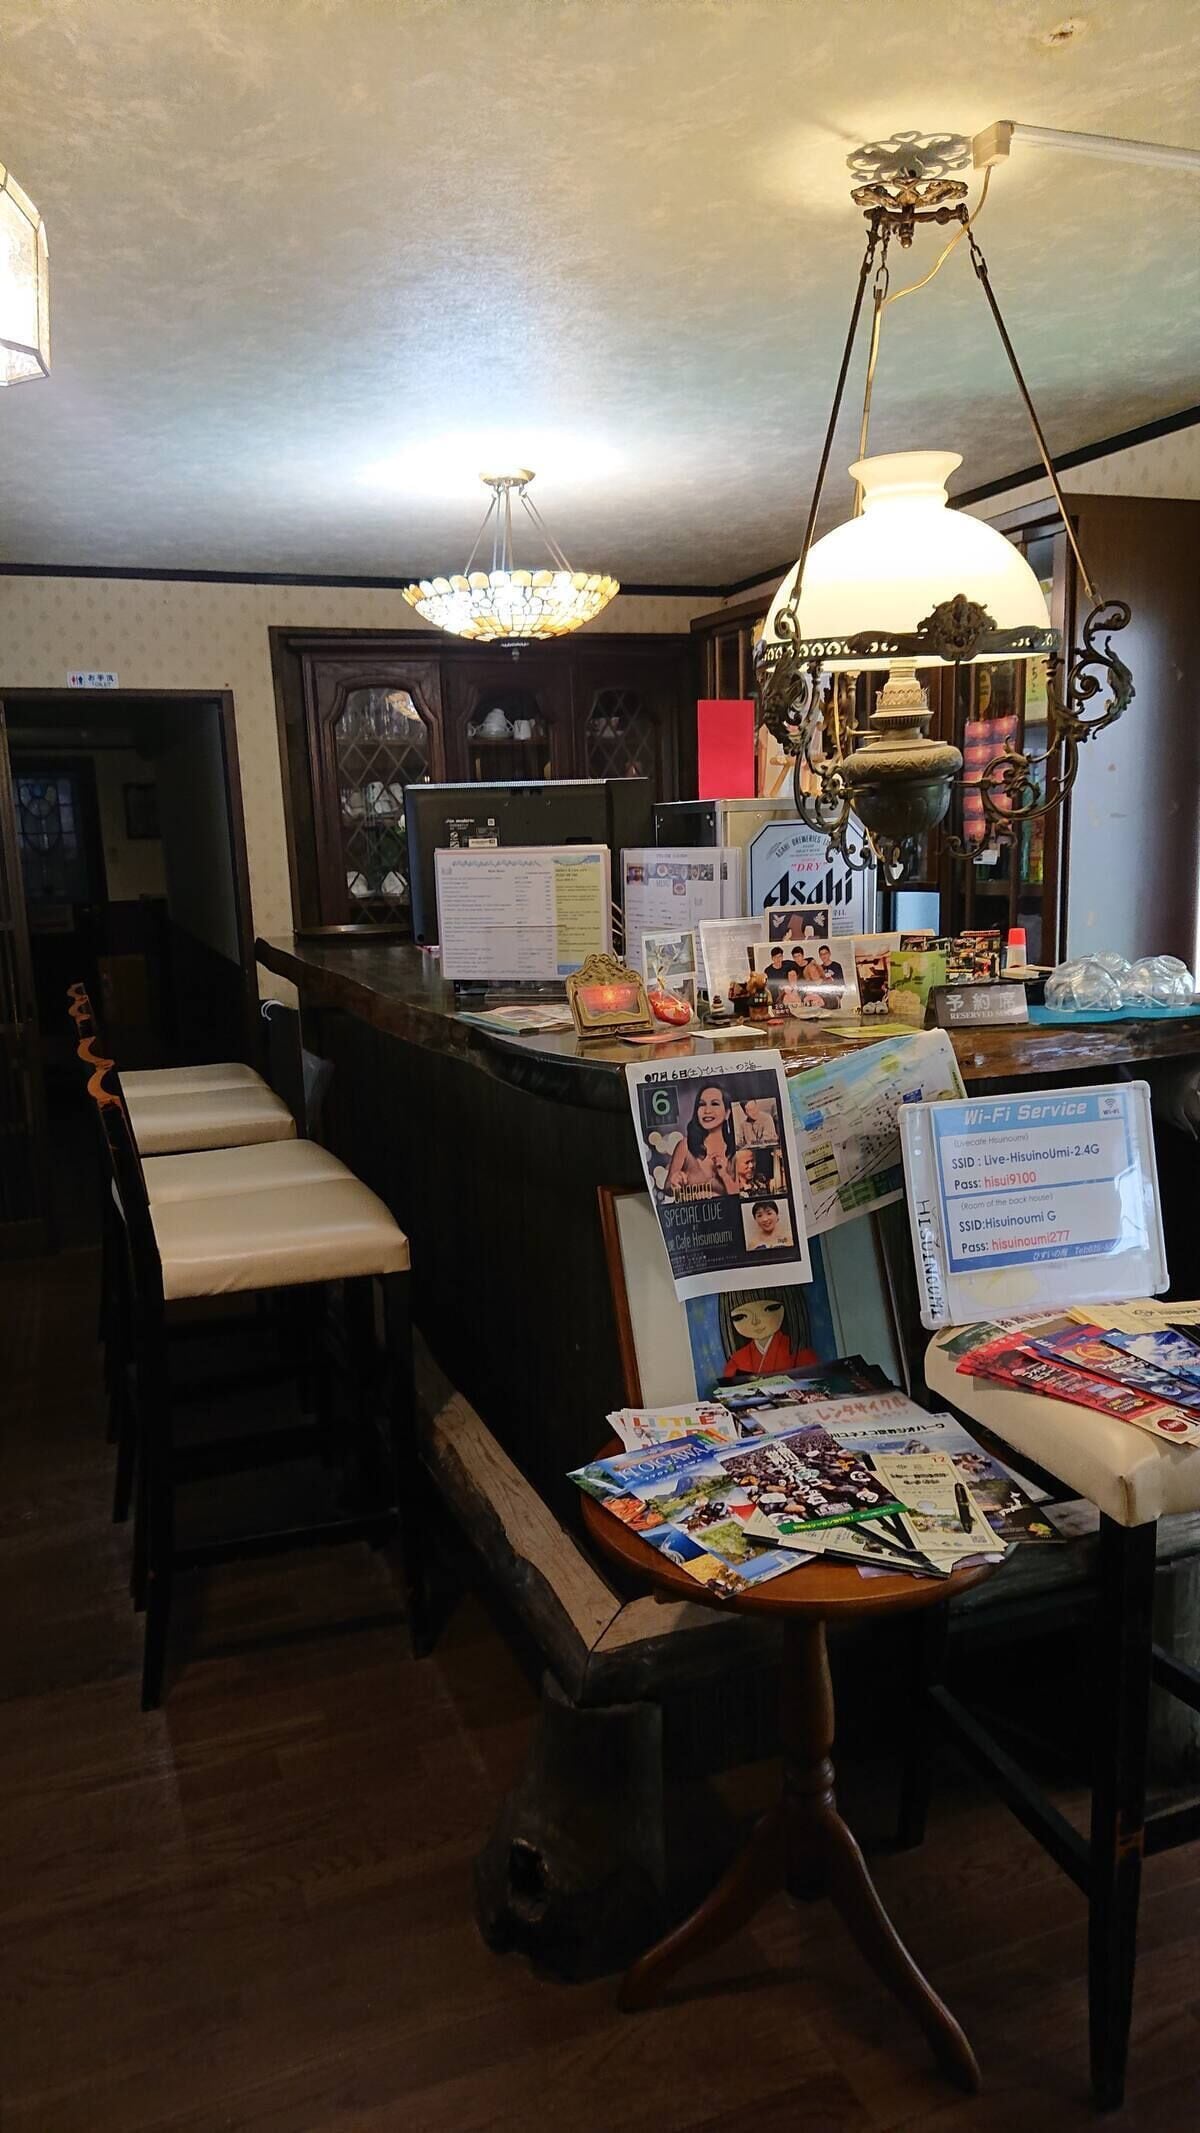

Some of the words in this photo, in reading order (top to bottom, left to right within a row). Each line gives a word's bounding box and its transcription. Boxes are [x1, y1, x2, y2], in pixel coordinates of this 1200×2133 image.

[763, 867, 853, 908] Asahi
[950, 1011, 994, 1020] RESERVED
[652, 1089, 671, 1116] 6
[964, 1107, 1011, 1126] Wi-Fi
[1017, 1101, 1087, 1121] Service
[952, 1158, 975, 1169] SSID
[984, 1143, 1100, 1166] Live-HisuinoUmi-2.4G
[954, 1178, 982, 1190] Pass:
[984, 1171, 1037, 1187] hisui9100
[664, 1205, 701, 1228] SPECIAL
[702, 1202, 724, 1222] LIVE
[1047, 1210, 1057, 1222] G
[675, 1232, 691, 1250] Cafe
[961, 1241, 989, 1254] Pass:
[991, 1229, 1071, 1251] hisuinoumi277
[632, 1414, 717, 1428] LITTLE
[616, 1446, 711, 1482] ITOIGAWA
